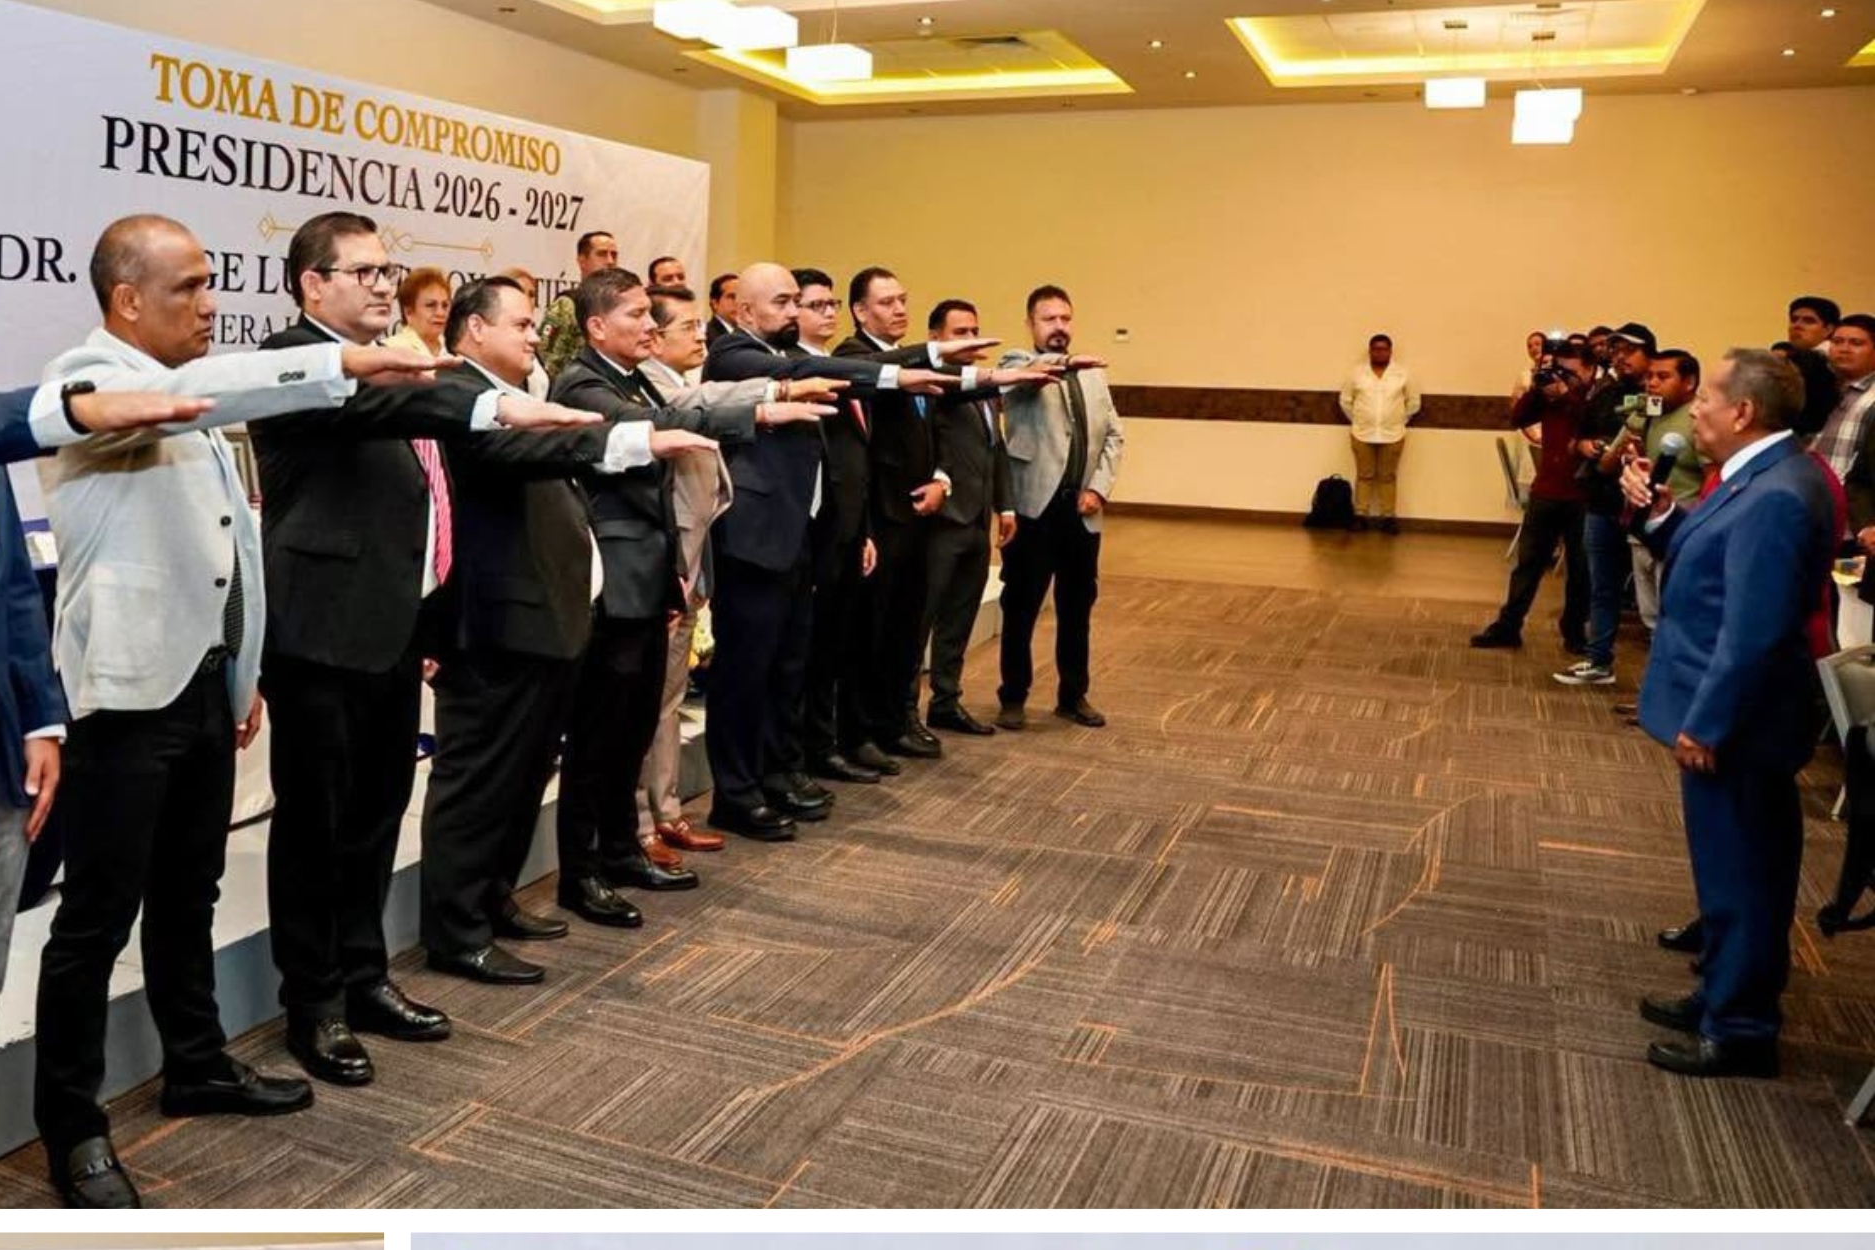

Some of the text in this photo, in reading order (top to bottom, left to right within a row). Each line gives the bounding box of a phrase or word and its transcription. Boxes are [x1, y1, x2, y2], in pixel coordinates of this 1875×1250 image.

[100, 115, 425, 211] PRESIDENCIA
[433, 173, 501, 222] 2026
[526, 188, 584, 233] 2027
[150, 53, 561, 177] TOMA DE COMPROMISO
